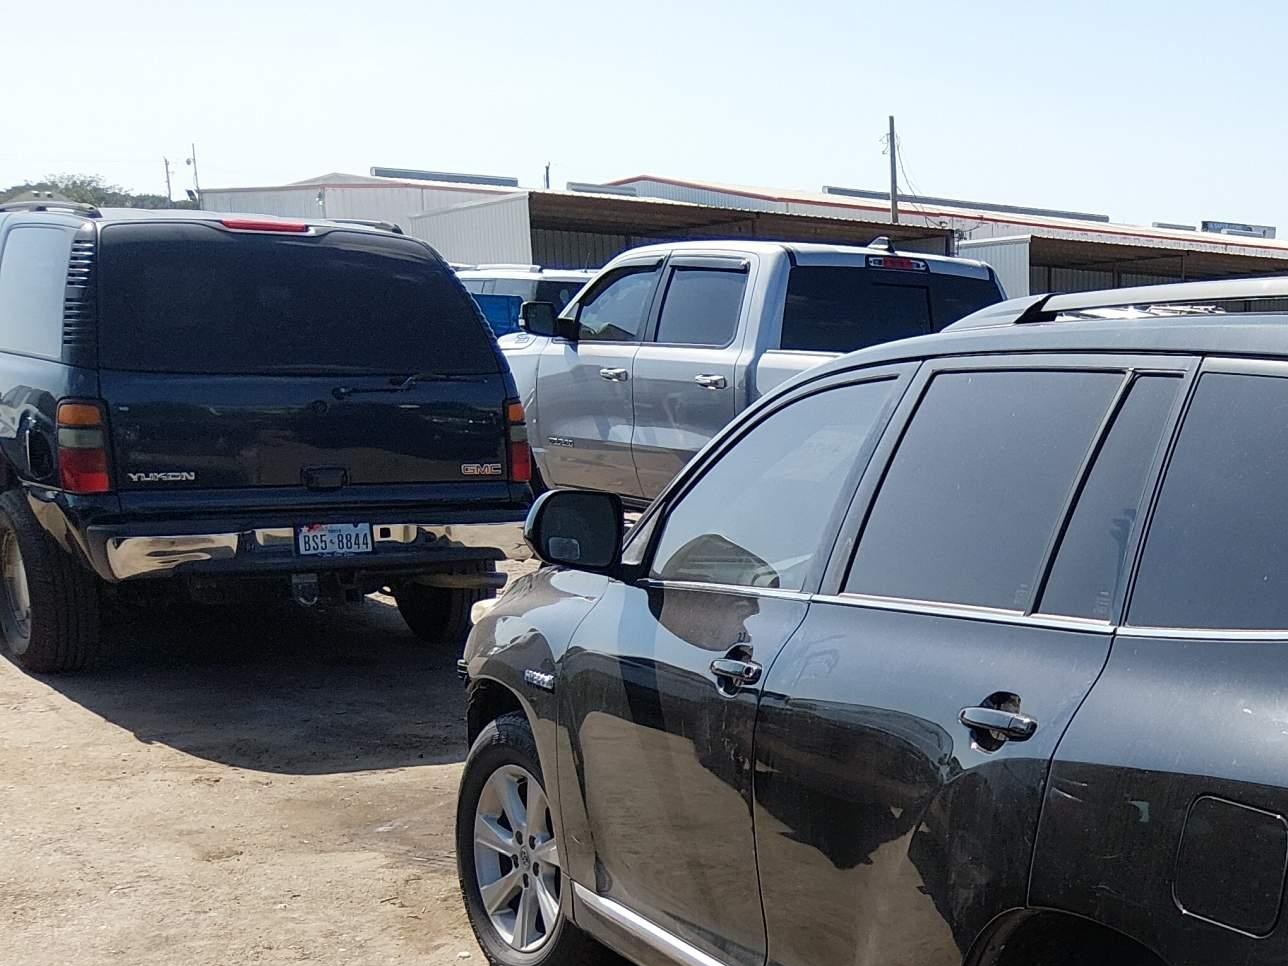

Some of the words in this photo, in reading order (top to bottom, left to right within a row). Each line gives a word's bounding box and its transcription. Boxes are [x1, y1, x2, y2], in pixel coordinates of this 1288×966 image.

[461, 464, 502, 475] GMC
[128, 472, 195, 481] YUKON
[337, 533, 369, 550] 8844
